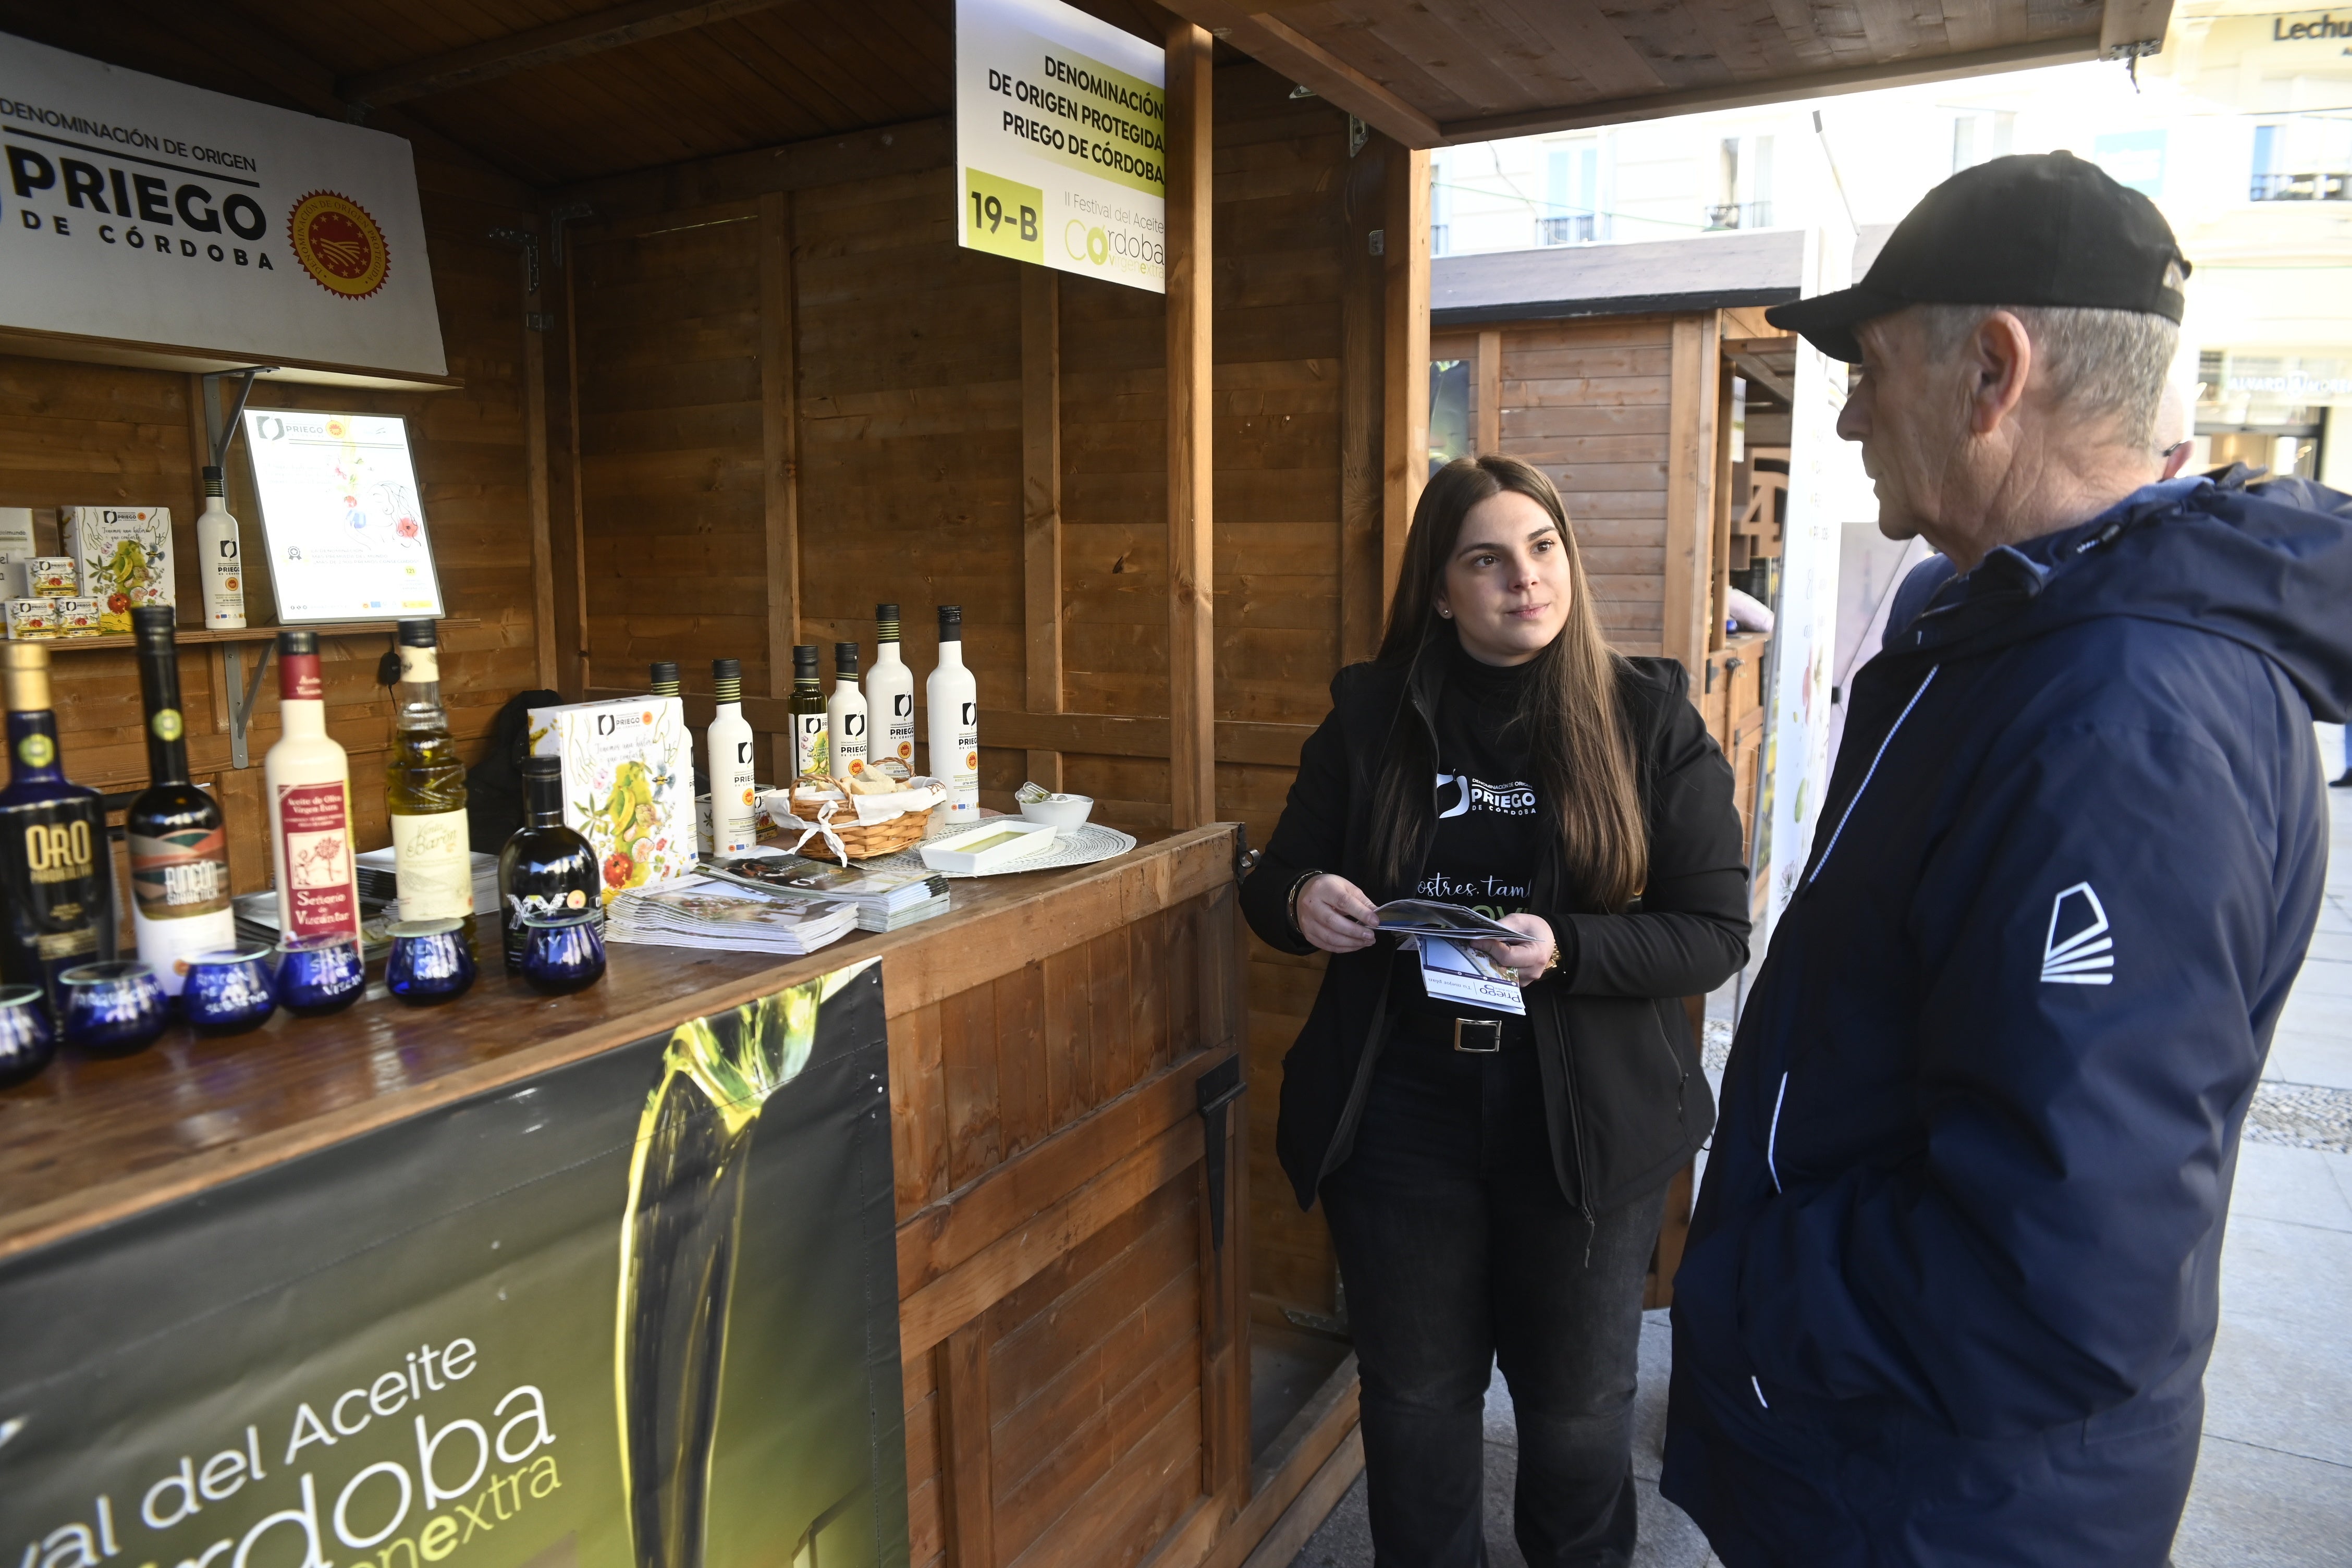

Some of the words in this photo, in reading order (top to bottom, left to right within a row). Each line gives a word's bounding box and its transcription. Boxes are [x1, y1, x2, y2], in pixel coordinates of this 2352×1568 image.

[989, 68, 1012, 97] DE
[1015, 80, 1078, 122] ORIGEN
[1082, 108, 1165, 154] PROTEGIDA
[1045, 55, 1163, 121] DENOMINACIÓN
[1, 97, 160, 153] DENOMINACIÓN
[163, 138, 188, 158] DE
[192, 145, 257, 174] ORIGEN
[1003, 110, 1064, 150] PRIEGO
[1068, 133, 1088, 159] DE
[1092, 142, 1165, 185] CÓRDOBA
[5, 144, 267, 242] PRIEGO
[971, 191, 1038, 243] 19-B
[1074, 193, 1112, 219] Festival
[1114, 206, 1131, 225] del
[1133, 212, 1164, 234] Aceite
[21, 210, 71, 237] DE
[98, 225, 274, 271] CÓRDOBA
[286, 425, 323, 434] PRIEGO
[616, 717, 640, 726] PRIEGO
[890, 727, 914, 736] PRIEGO
[1471, 788, 1536, 808] PRIEGO
[1472, 778, 1509, 790] DENOMINACIÓN
[1489, 805, 1536, 816] CÓRDOBA
[26, 819, 92, 871] ORO
[1479, 984, 1522, 1003] Priego
[142, 1425, 266, 1529] del
[285, 1338, 476, 1464] Aceite
